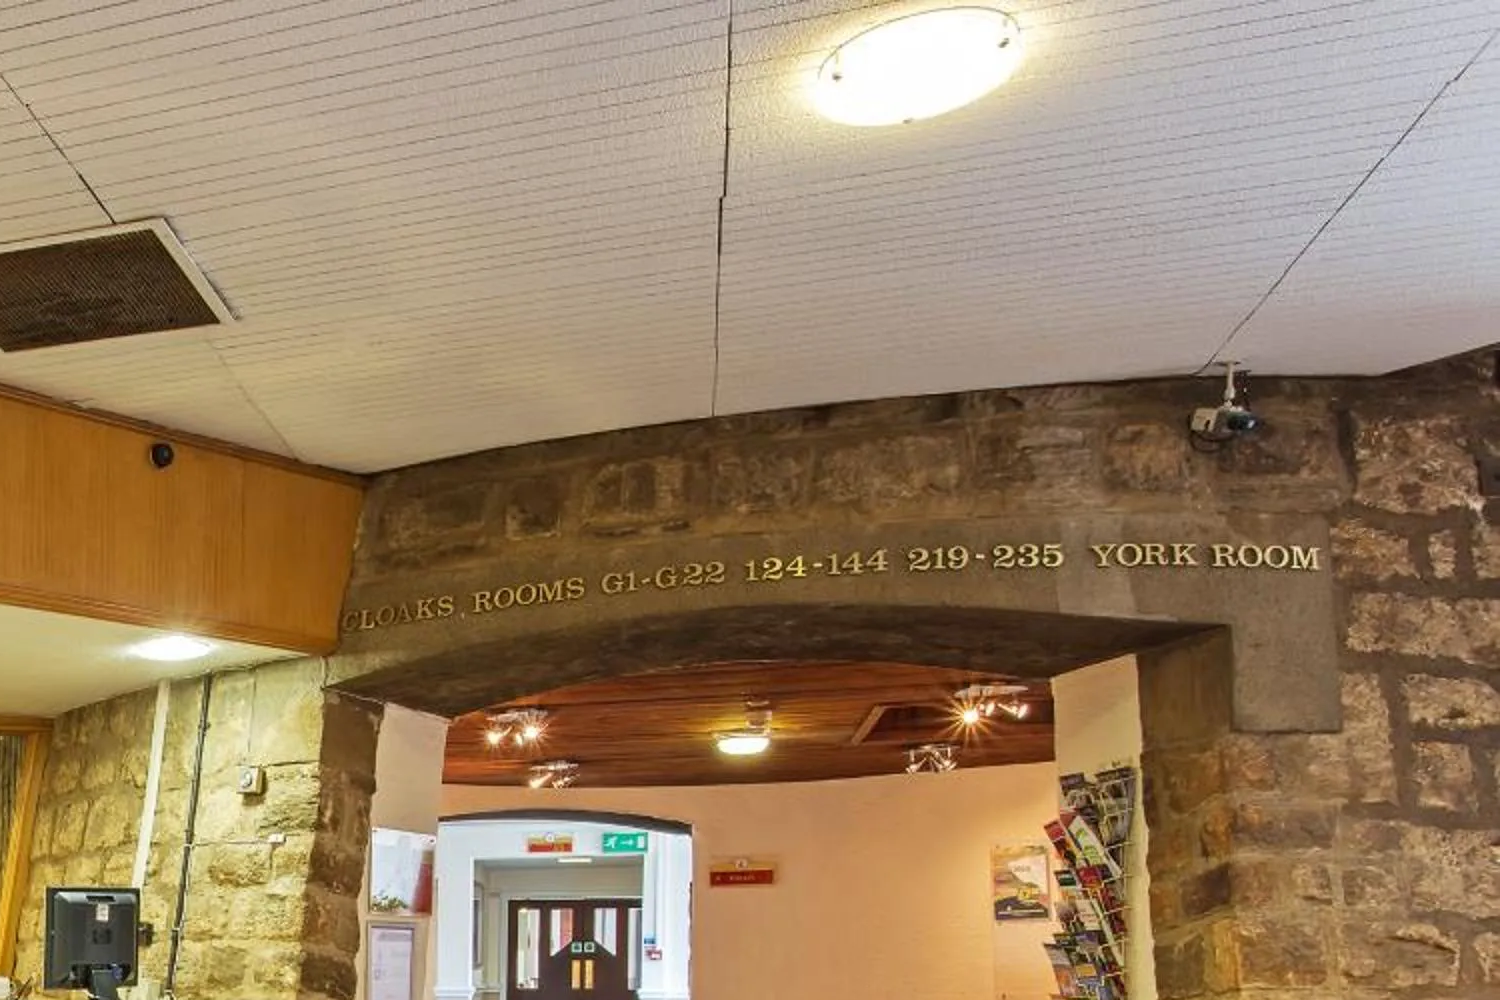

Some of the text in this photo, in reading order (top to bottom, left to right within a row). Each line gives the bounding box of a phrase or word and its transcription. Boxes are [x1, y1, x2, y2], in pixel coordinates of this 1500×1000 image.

[473, 577, 585, 613] ROOMS
[601, 561, 725, 595] G1-G22
[745, 548, 889, 581] 124-144
[908, 543, 1065, 571] 219-235
[1091, 543, 1199, 567] YORK
[1211, 543, 1321, 570] ROOM
